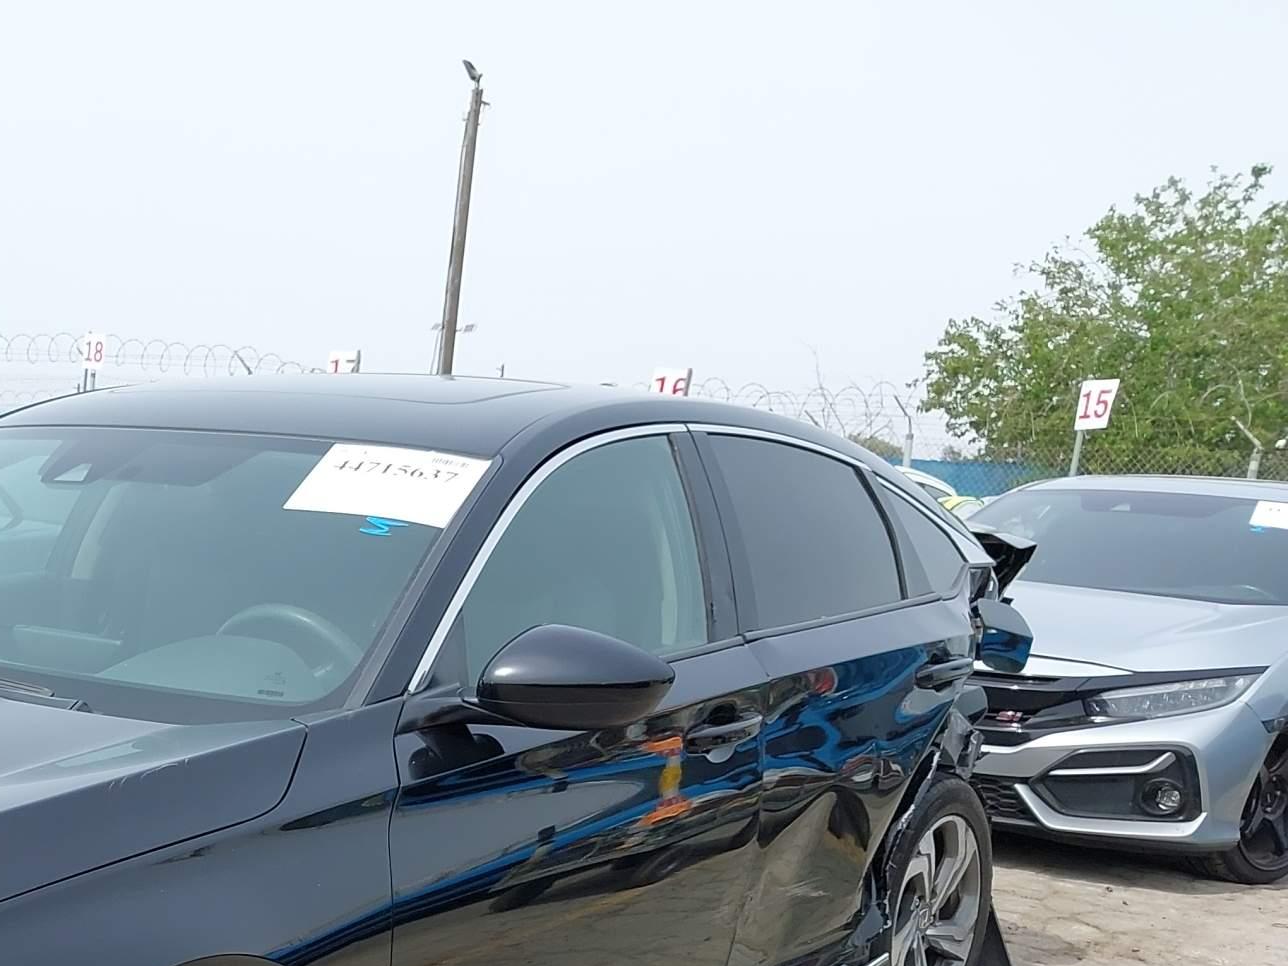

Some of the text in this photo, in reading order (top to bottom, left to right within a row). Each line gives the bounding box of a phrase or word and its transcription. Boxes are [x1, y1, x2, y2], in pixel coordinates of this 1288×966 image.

[85, 340, 104, 362] 18
[1078, 389, 1113, 420] 15
[333, 460, 459, 483] 44715637
